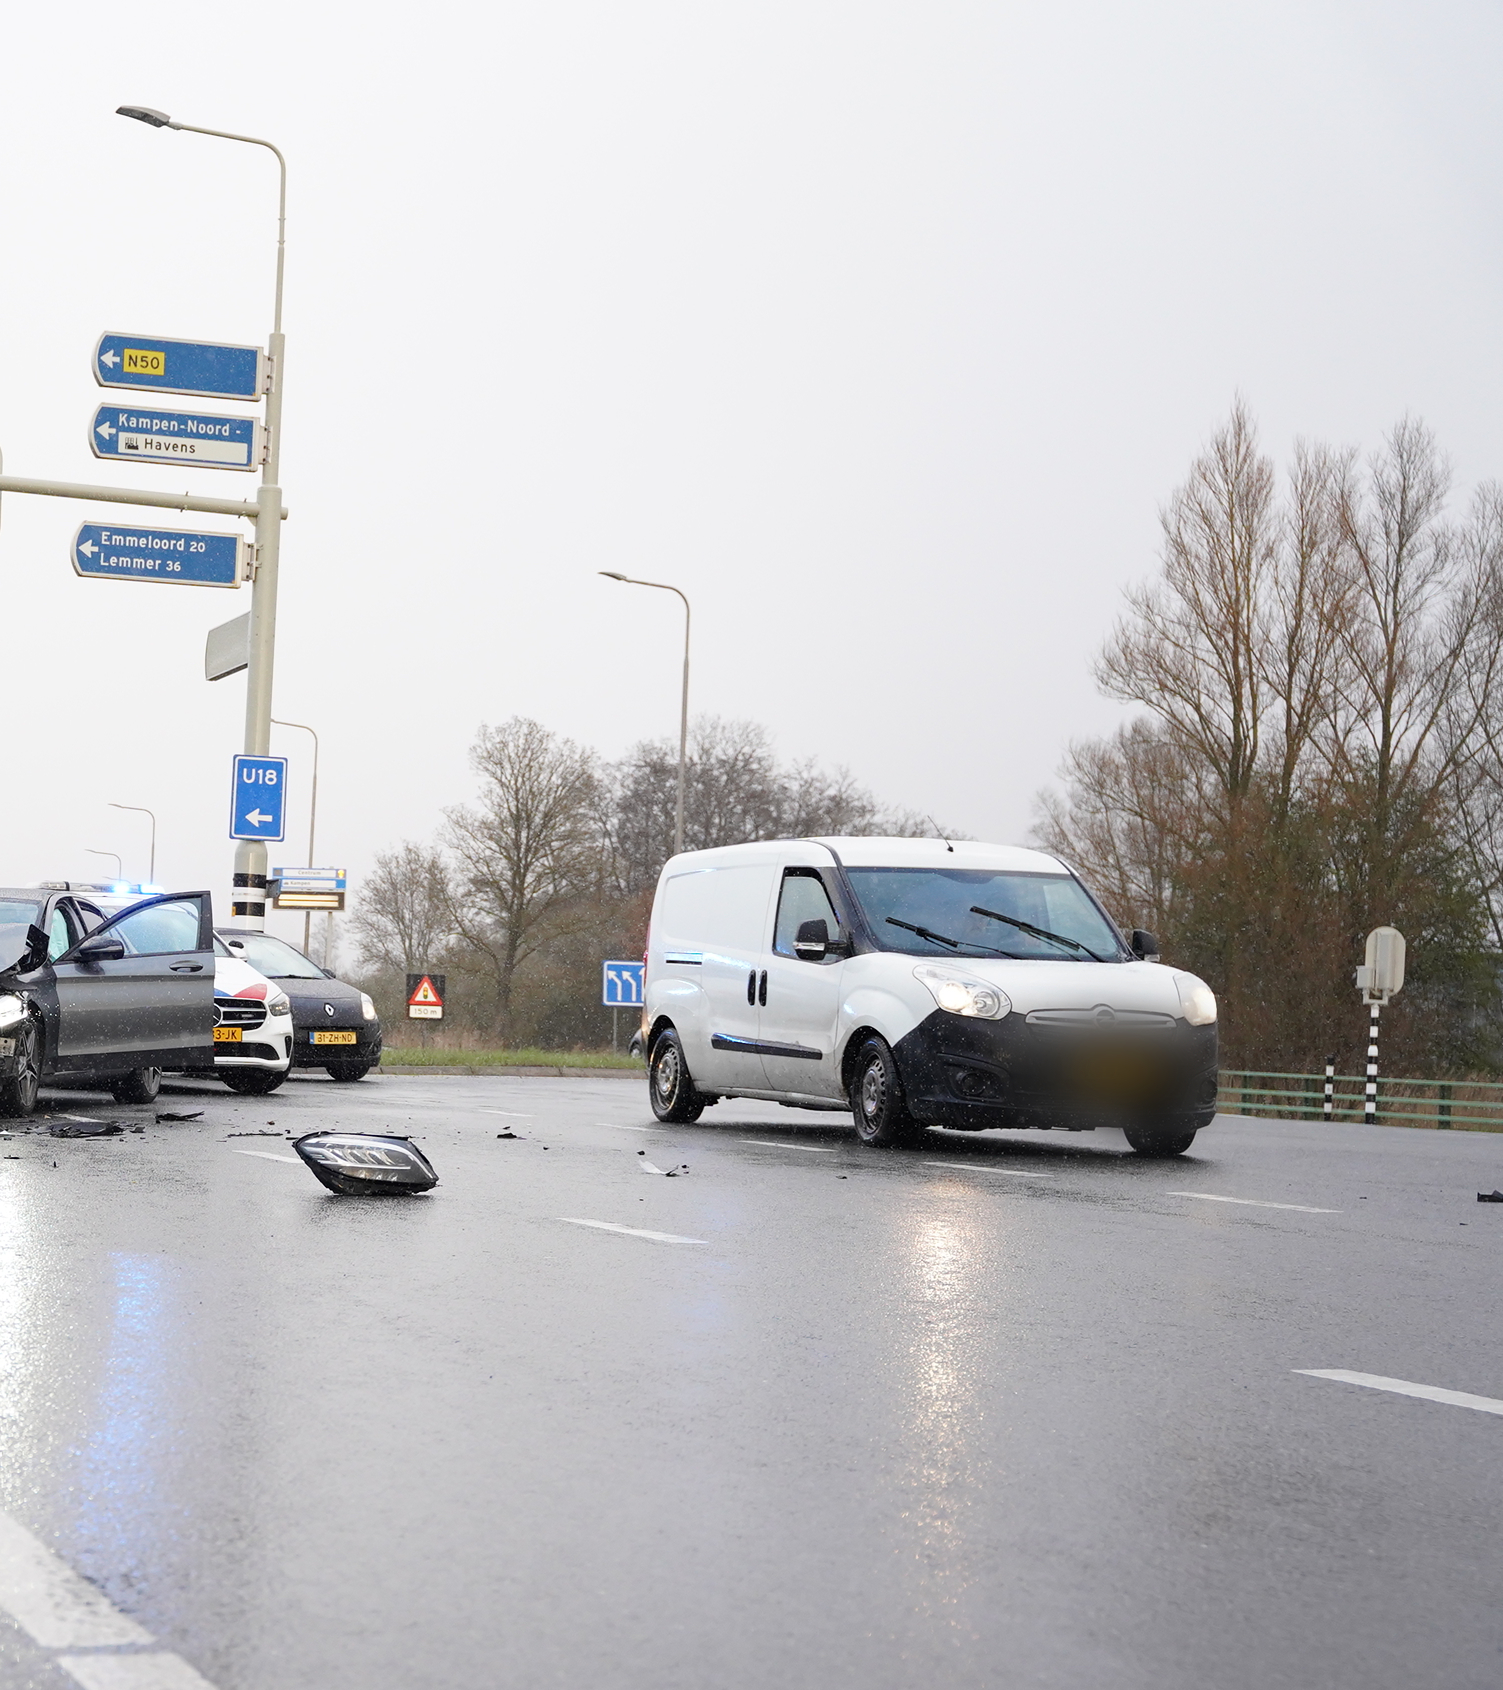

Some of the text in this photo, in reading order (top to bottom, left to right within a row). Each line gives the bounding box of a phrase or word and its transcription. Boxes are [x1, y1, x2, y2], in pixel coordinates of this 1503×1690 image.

[128, 354, 160, 370] N50
[118, 413, 230, 436] Kampen-Noord
[144, 438, 196, 454] Havens
[101, 531, 206, 552] Emmeloord 20
[100, 552, 181, 572] Lemmer 36
[243, 768, 277, 785] U18
[212, 1029, 238, 1040] 3-JK
